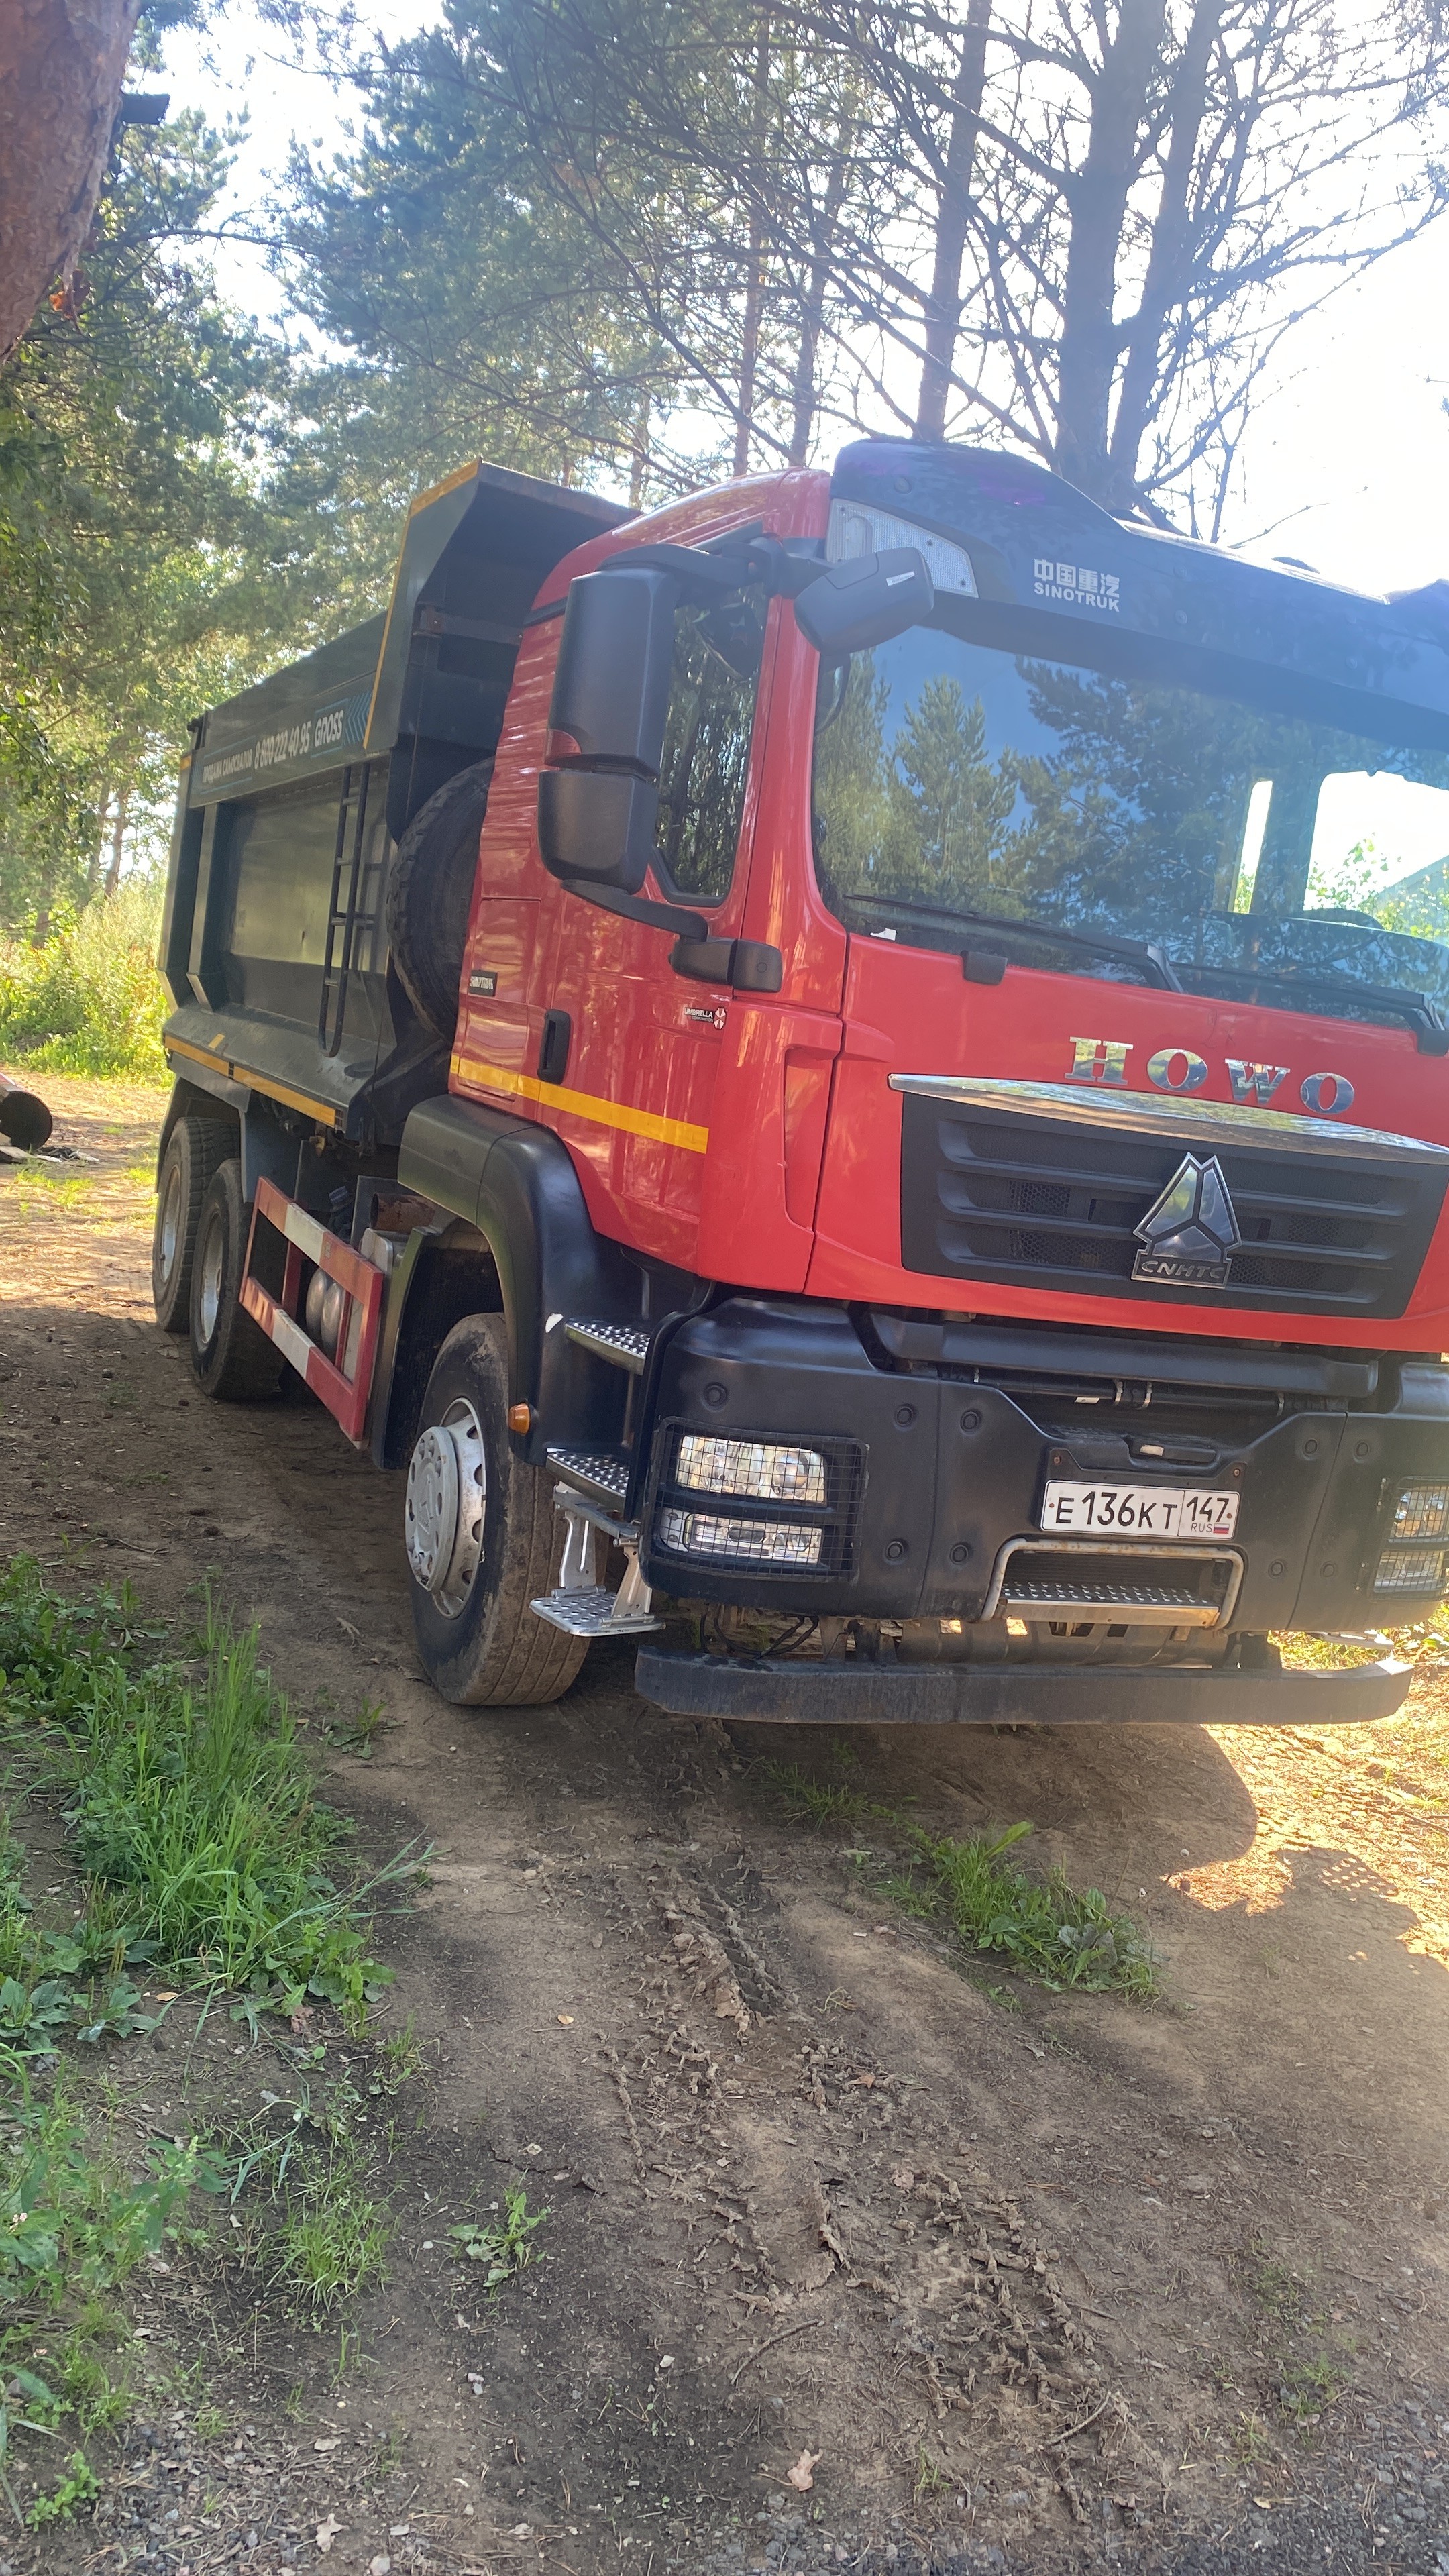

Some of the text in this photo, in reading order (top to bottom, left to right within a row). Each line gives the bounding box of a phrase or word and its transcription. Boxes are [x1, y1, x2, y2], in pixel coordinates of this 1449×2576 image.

[1034, 559, 1120, 598] 中国重汽
[1034, 582, 1120, 612] SINOTRUK
[274, 729, 288, 763] 222
[288, 725, 300, 757] 40
[299, 720, 311, 755] 95
[314, 710, 344, 747] GROSS
[685, 1008, 713, 1018] UMBRELLA
[1065, 1036, 1355, 1114] HOWO
[1141, 1260, 1224, 1279] CNHTC
[1186, 1496, 1230, 1522] 147
[1191, 1523, 1212, 1533] RUS
